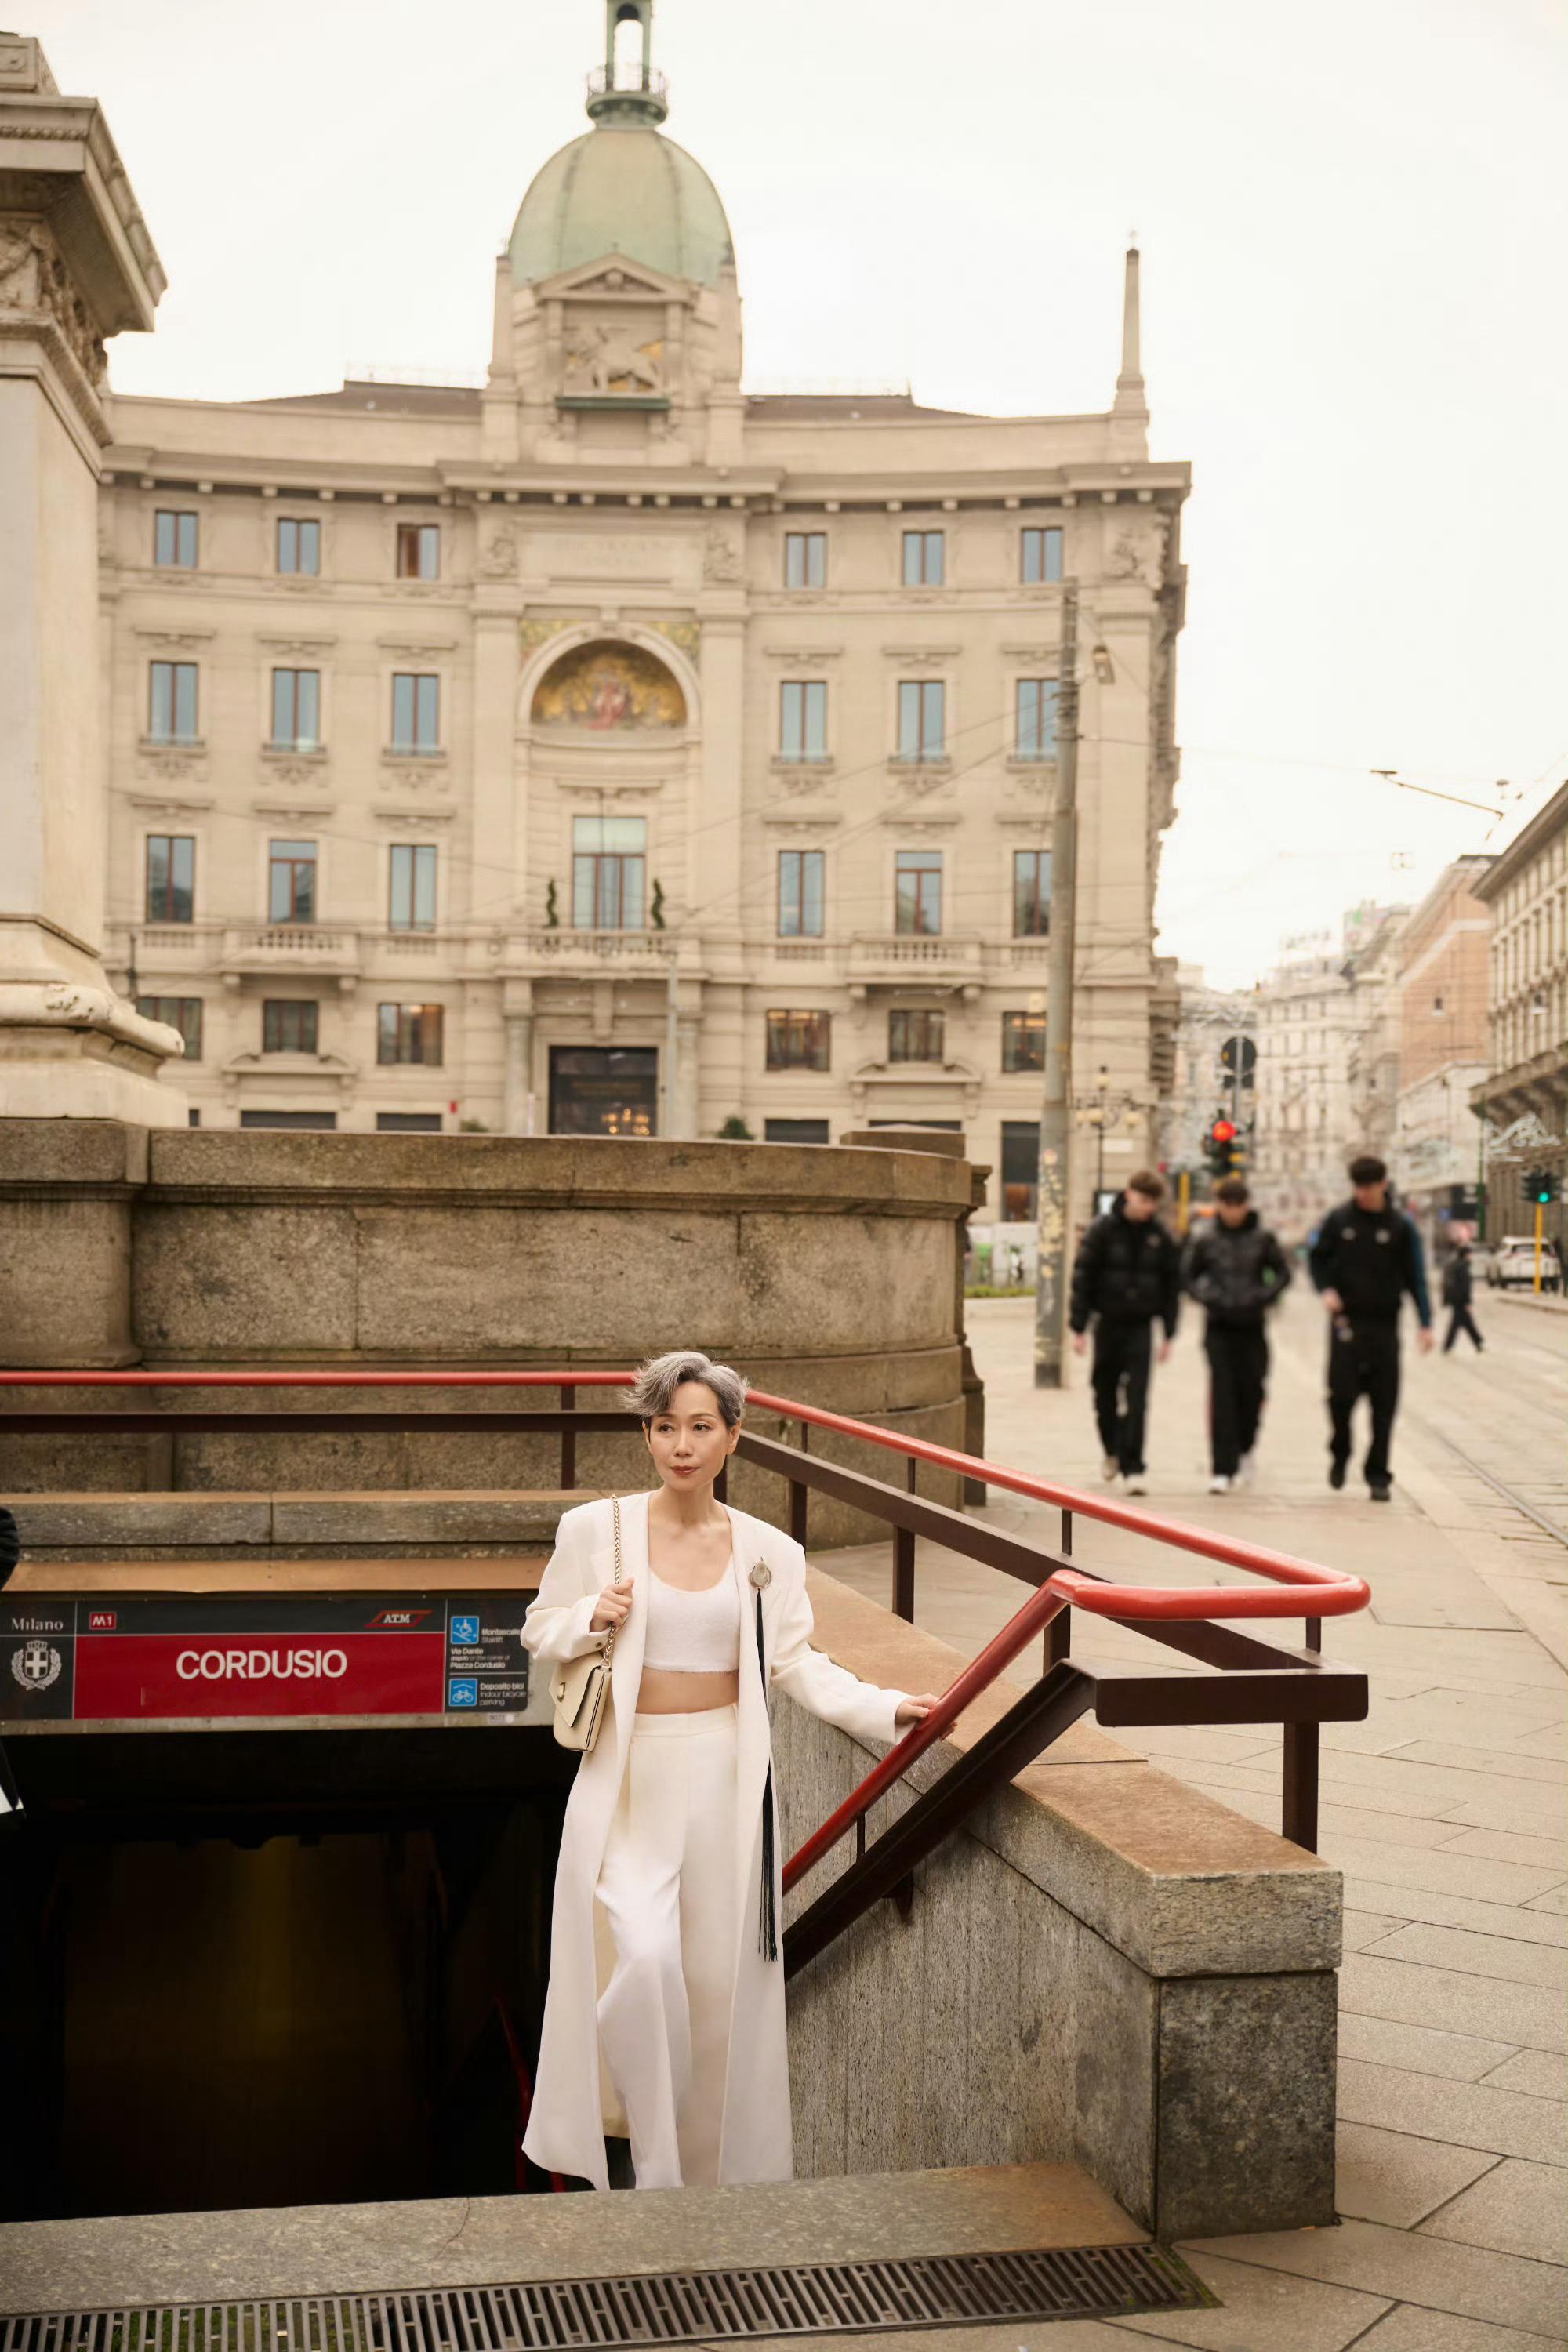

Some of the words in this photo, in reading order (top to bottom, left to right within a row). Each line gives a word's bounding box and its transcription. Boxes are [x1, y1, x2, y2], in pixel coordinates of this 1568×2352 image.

[11, 1617, 64, 1631] Milano
[92, 1616, 113, 1626] M1
[383, 1613, 411, 1624] ATM
[176, 1649, 347, 1679] CORDUSIO
[503, 1690, 526, 1699] bicycle
